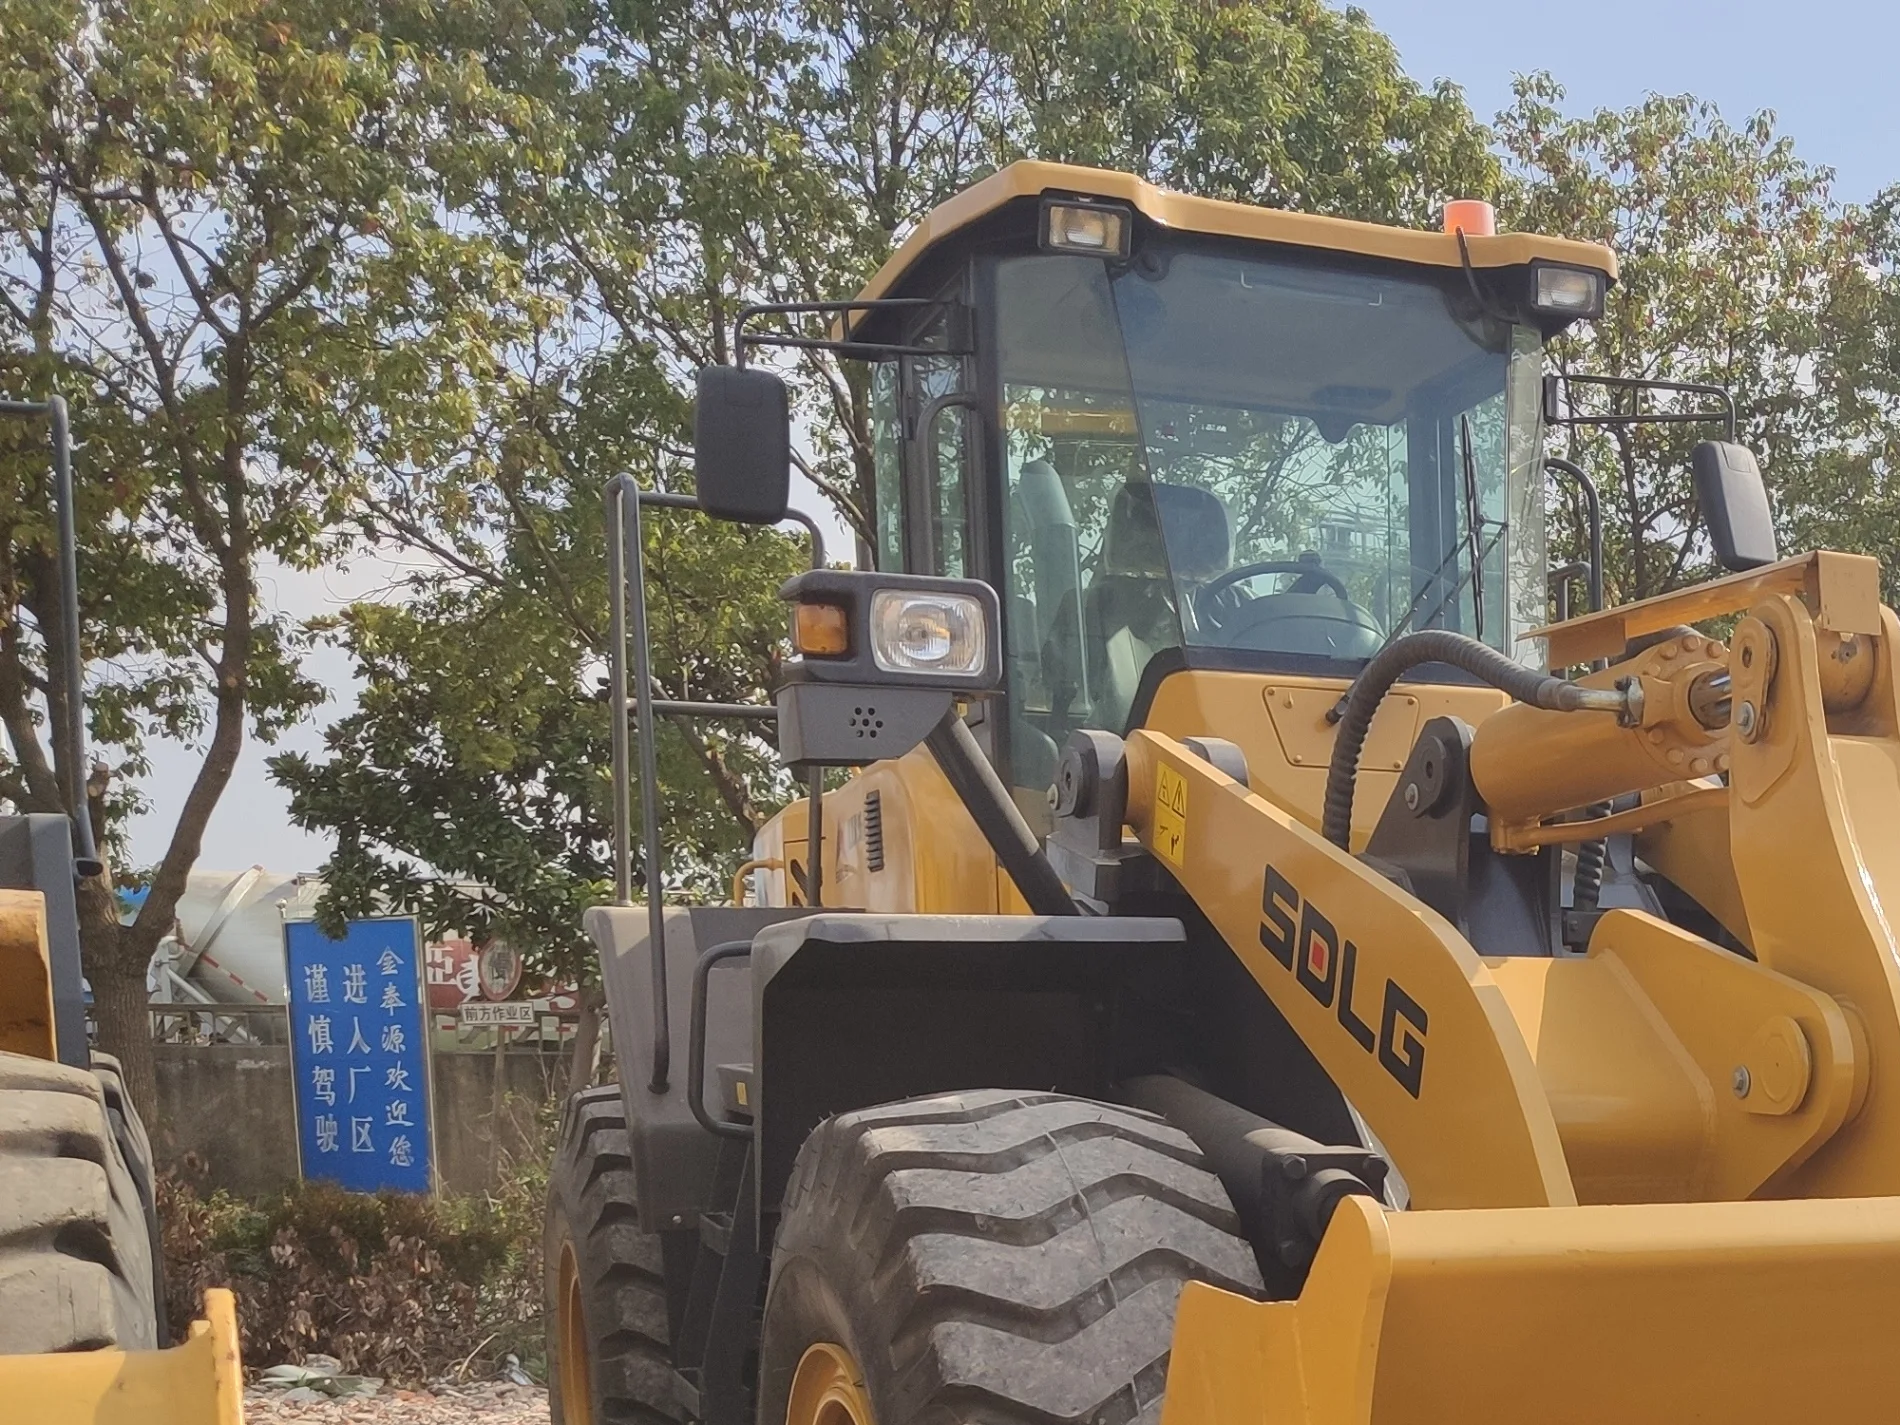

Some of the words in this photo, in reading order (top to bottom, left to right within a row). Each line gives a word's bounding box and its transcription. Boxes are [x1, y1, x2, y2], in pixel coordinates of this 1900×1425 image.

[304, 963, 340, 1153] 谨慎驾驶
[463, 1003, 532, 1021] 前方作业区
[1259, 863, 1428, 1100] SDLG
